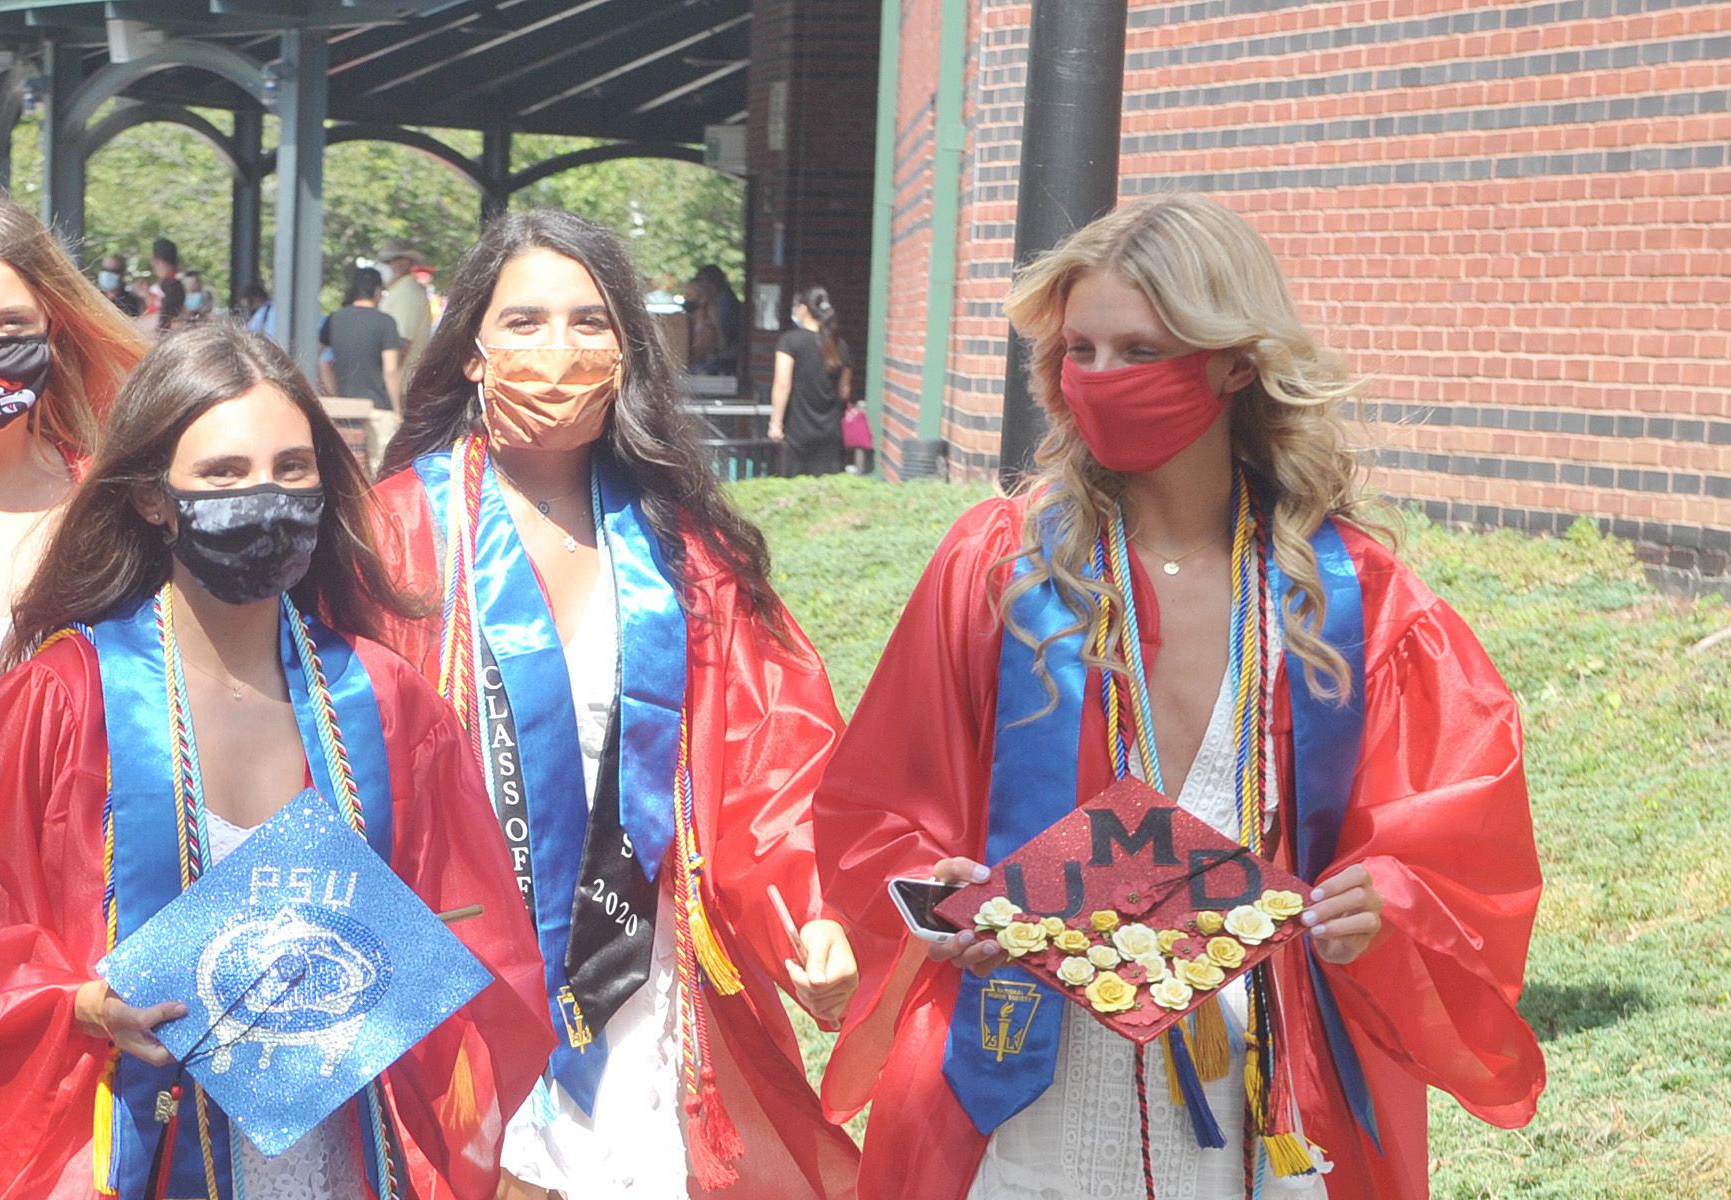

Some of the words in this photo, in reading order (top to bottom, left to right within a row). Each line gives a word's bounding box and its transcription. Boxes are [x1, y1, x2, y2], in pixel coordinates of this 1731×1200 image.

[482, 666, 520, 805] CLASS
[249, 865, 358, 908] PSU
[591, 878, 638, 937] 2020
